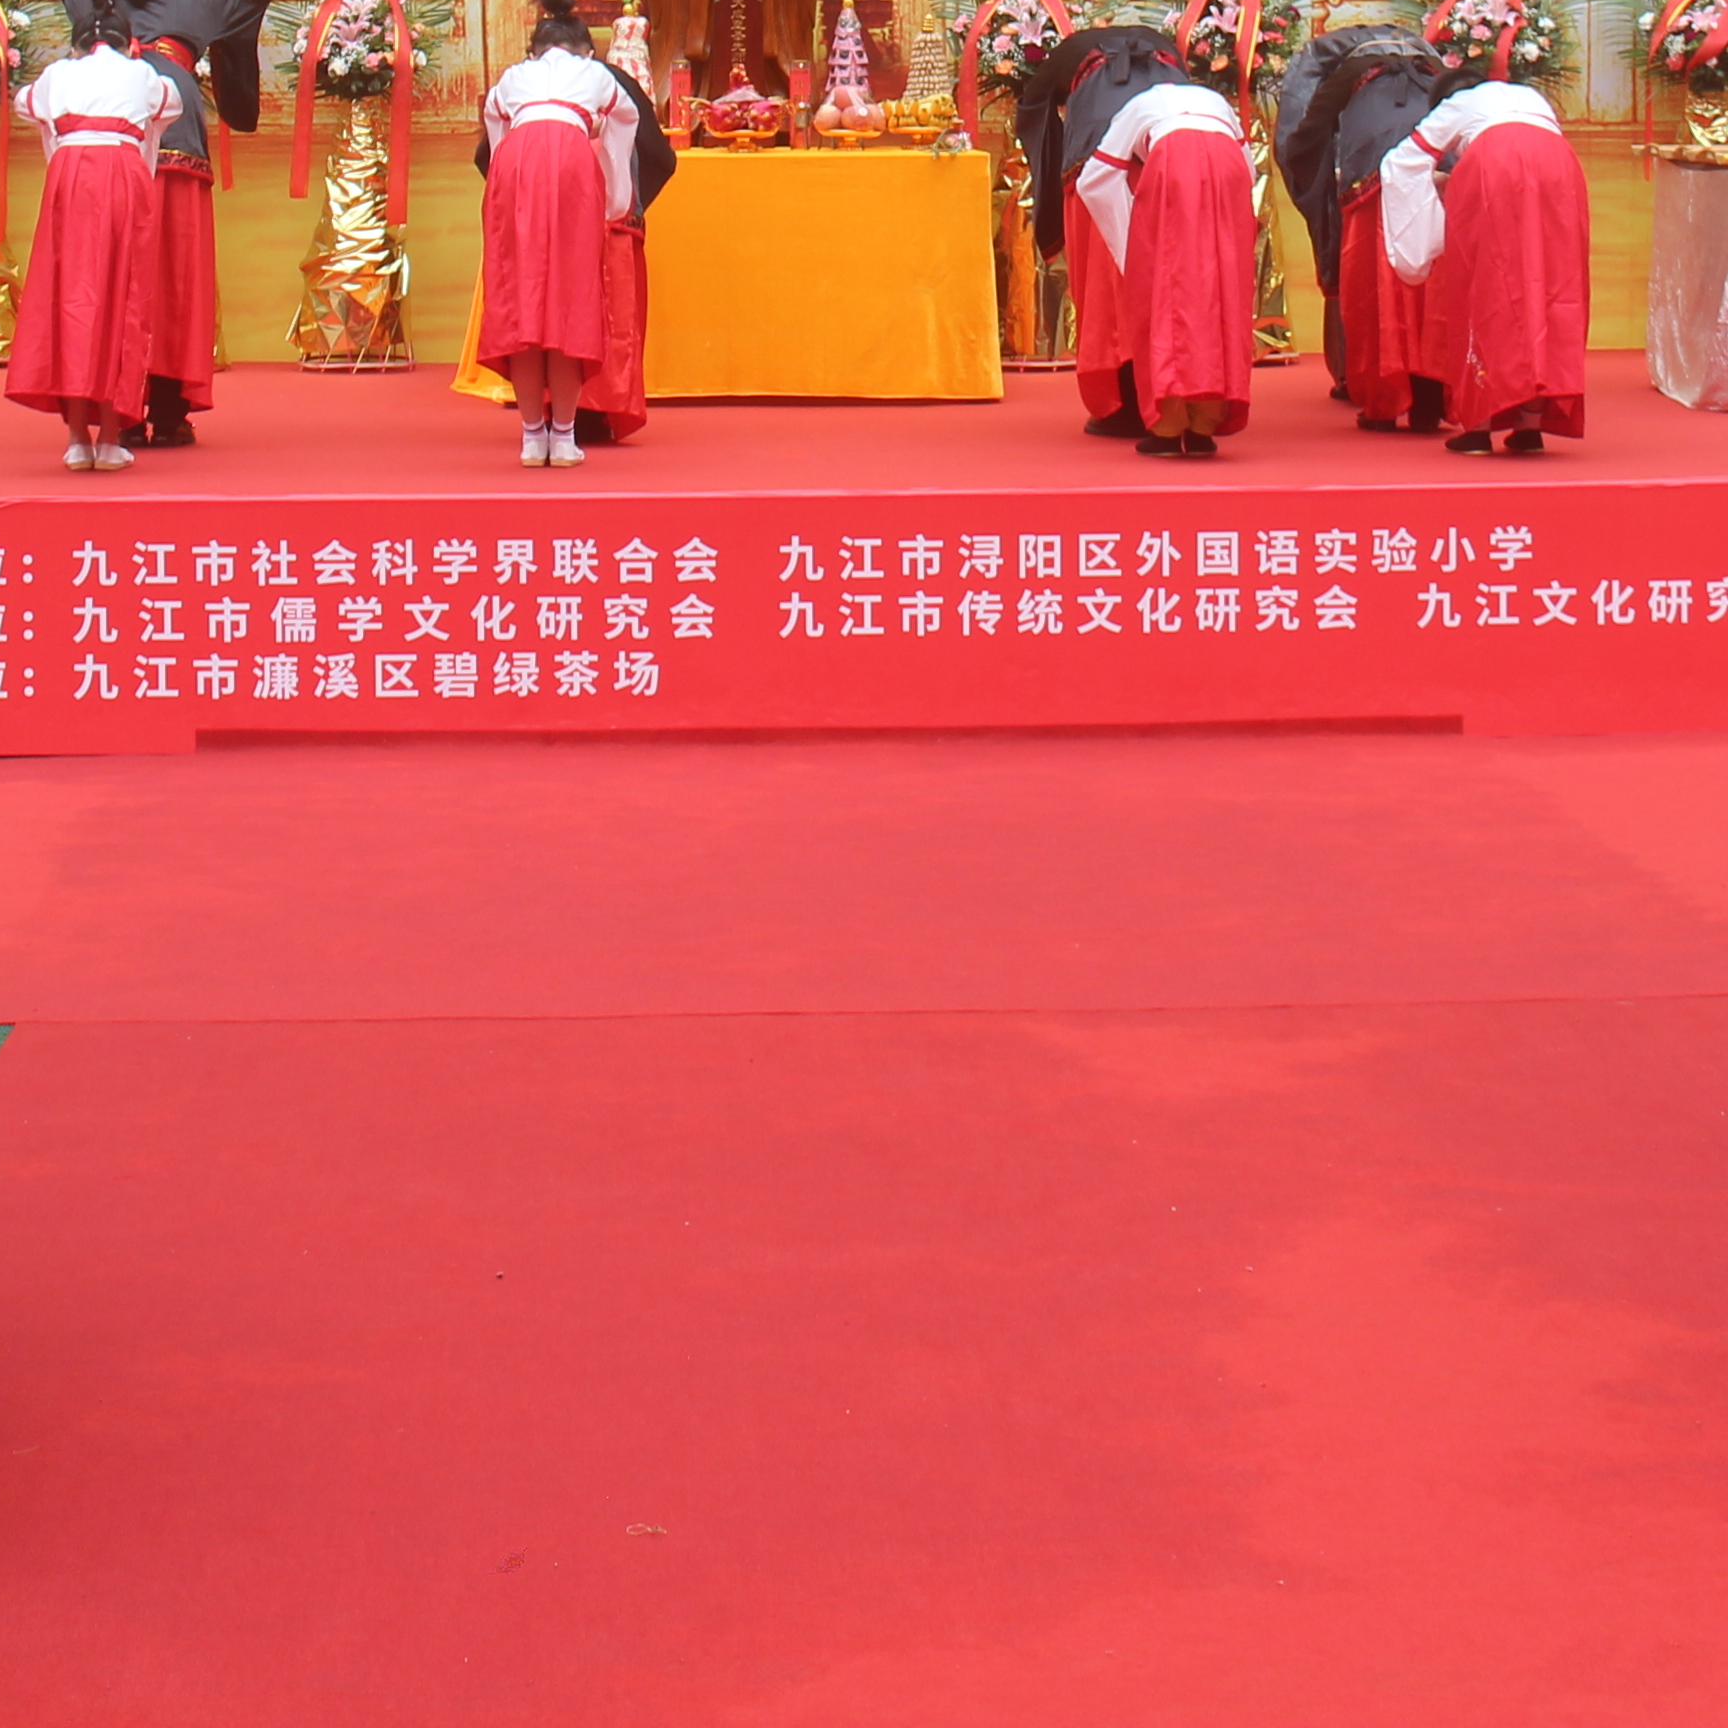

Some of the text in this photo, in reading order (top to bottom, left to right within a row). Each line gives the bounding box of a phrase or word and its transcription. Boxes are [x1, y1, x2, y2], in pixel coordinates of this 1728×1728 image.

[779, 526, 1535, 583] 九江市浔阳区外国语实验小学
[779, 586, 1361, 640] 九江市传统文化研究会
